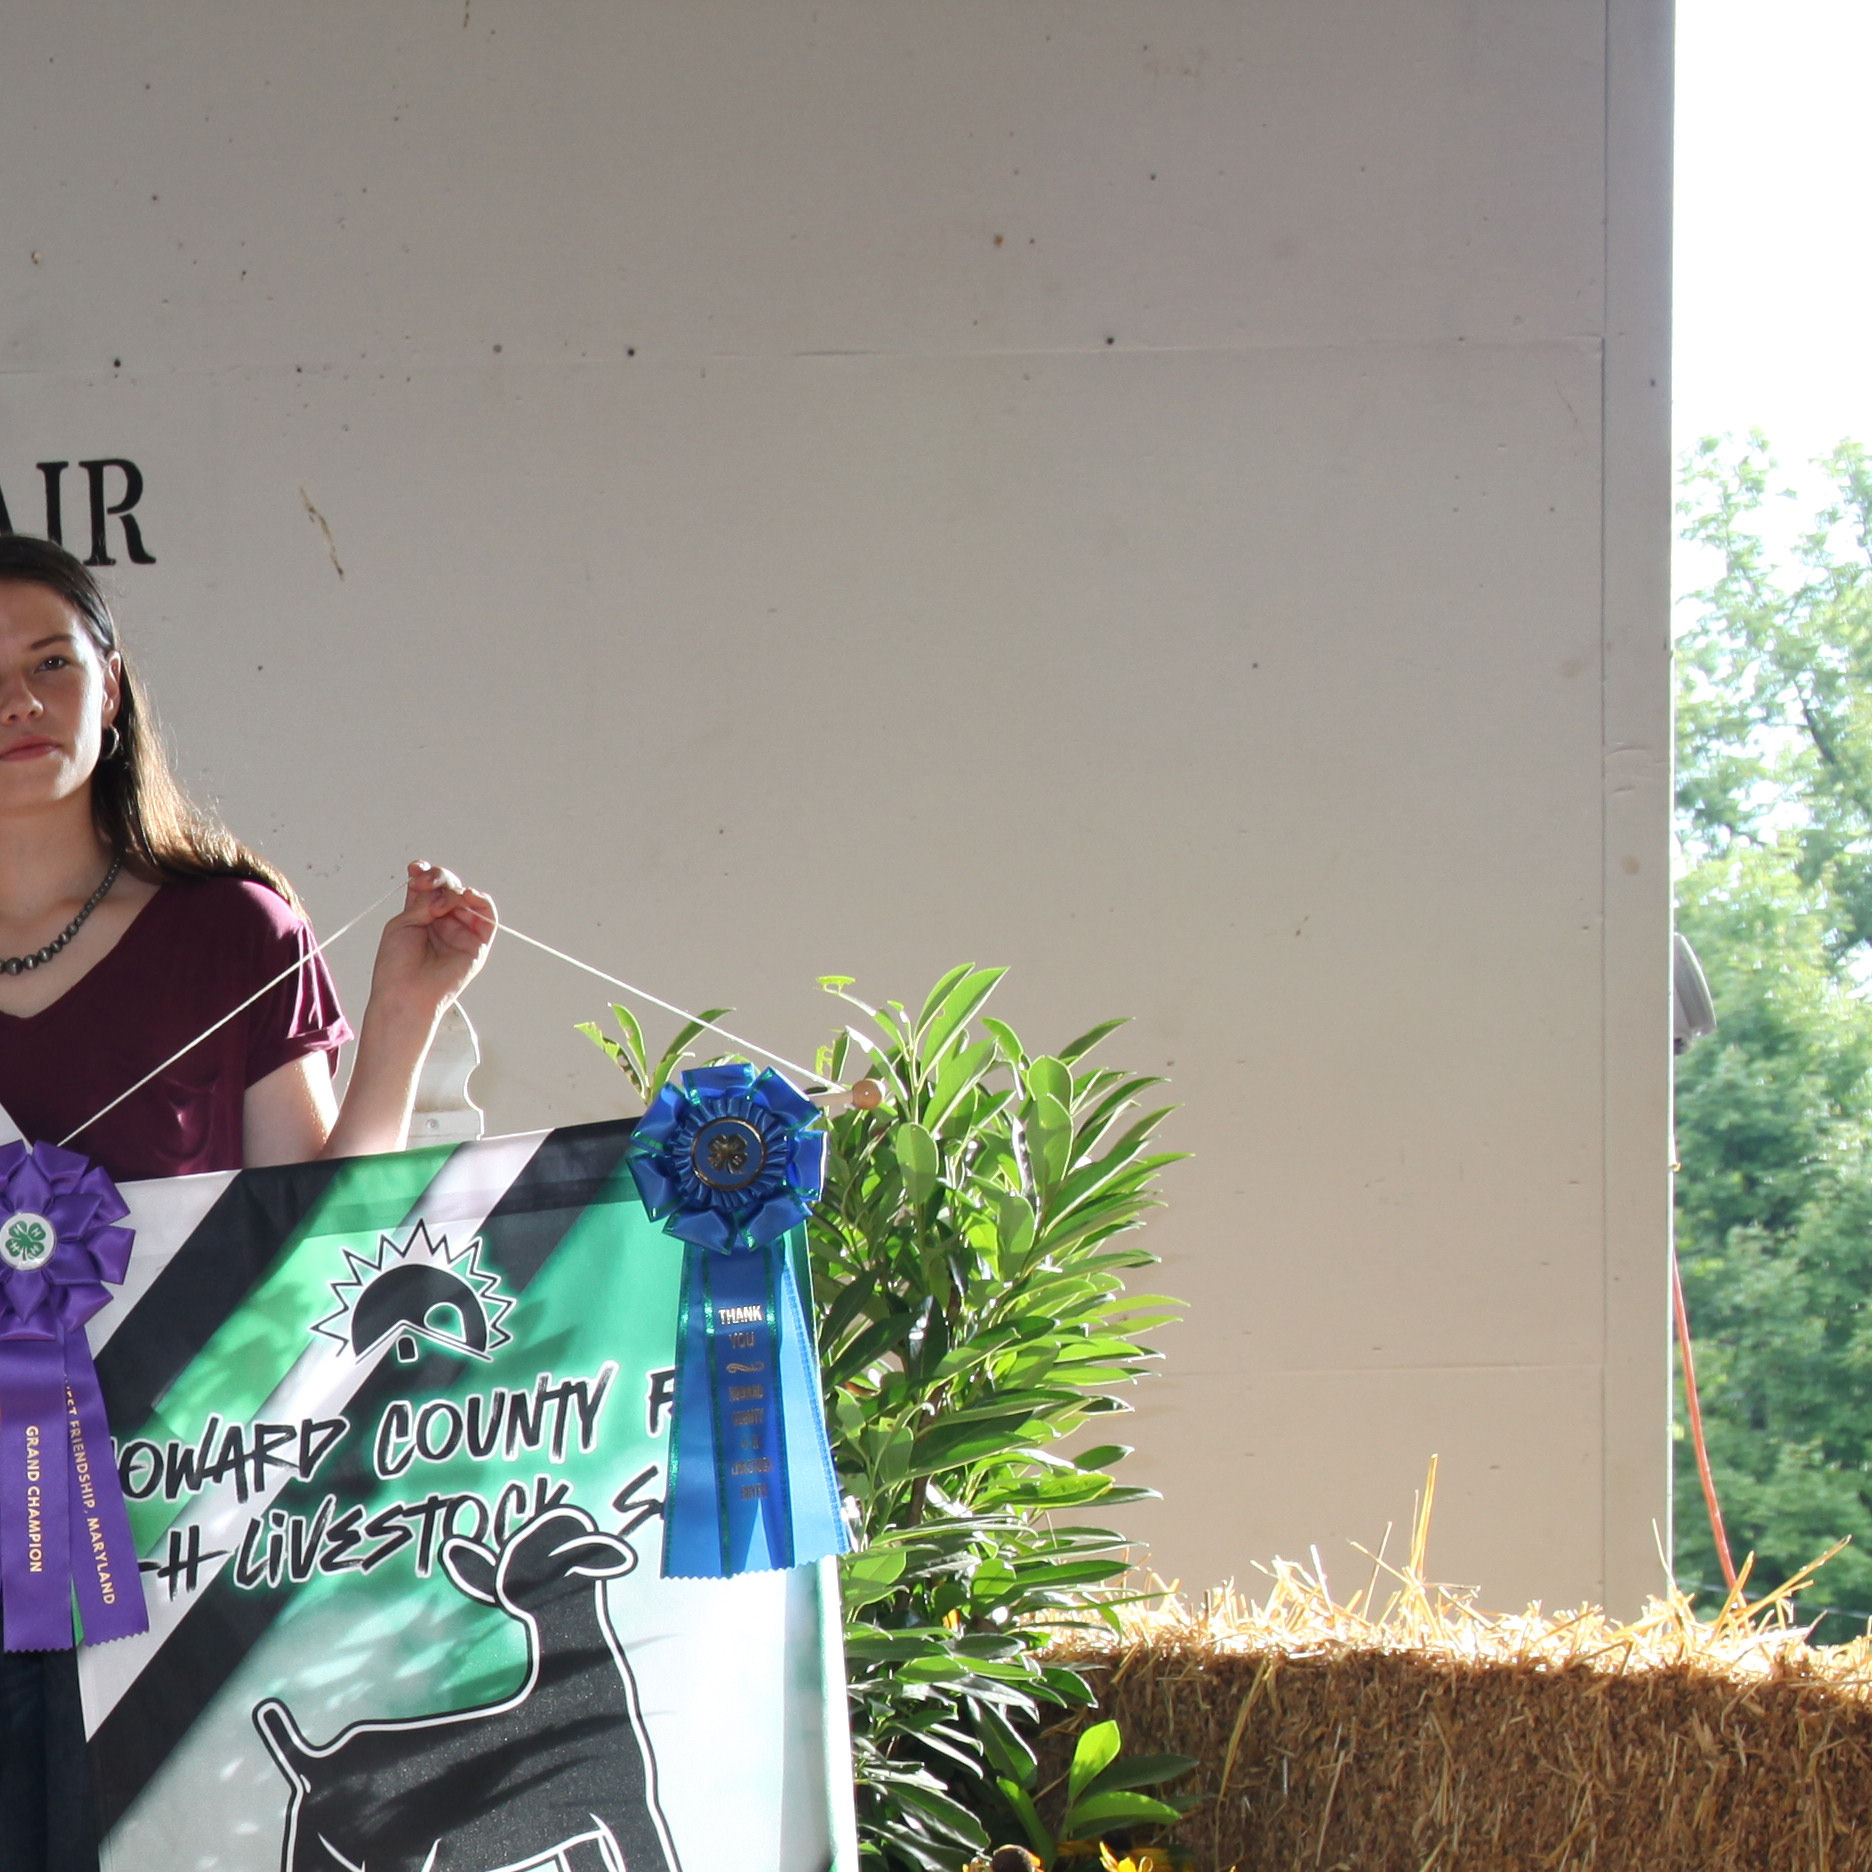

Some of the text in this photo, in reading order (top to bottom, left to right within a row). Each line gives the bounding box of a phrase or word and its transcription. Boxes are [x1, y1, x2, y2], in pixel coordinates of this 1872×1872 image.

[718, 1305, 763, 1325] THANK
[111, 1416, 347, 1504] OWARD
[375, 1363, 617, 1477] COUNTY
[25, 1425, 43, 1573] GRAND CHAMPION
[86, 1517, 115, 1605] MARYLAND
[138, 1524, 228, 1602] -H
